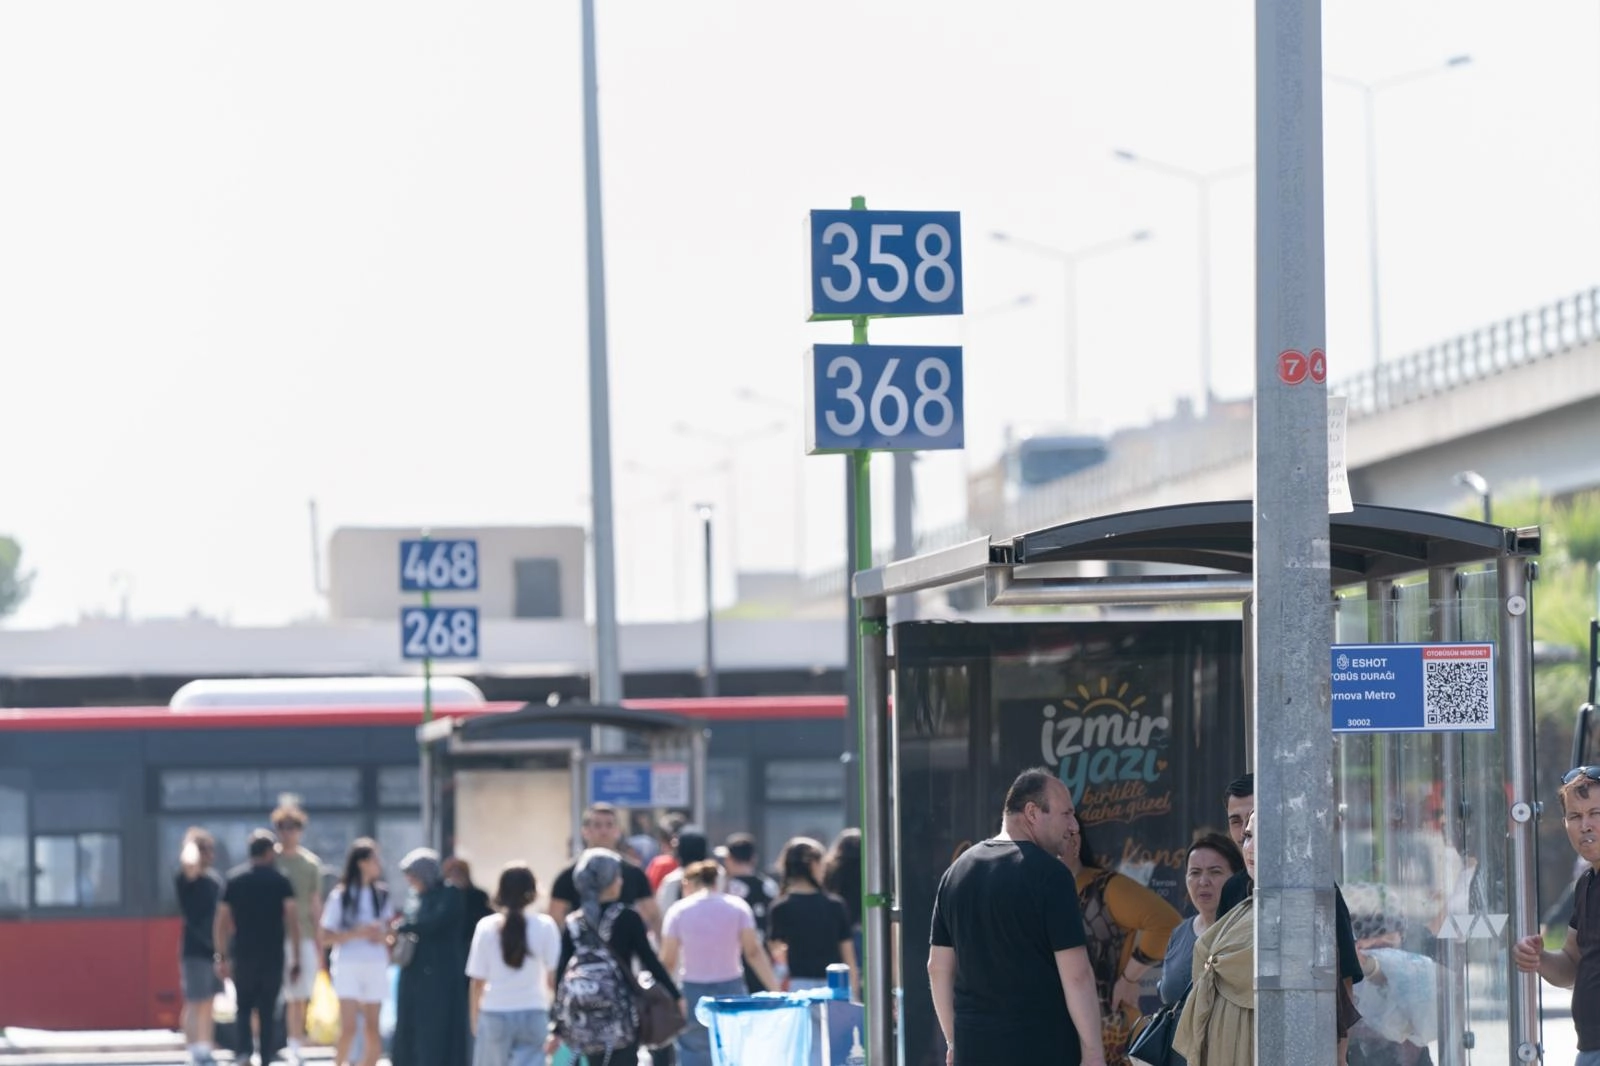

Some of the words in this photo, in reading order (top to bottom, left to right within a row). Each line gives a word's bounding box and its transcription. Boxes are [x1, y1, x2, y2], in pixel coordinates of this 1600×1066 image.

[820, 222, 955, 303] 358
[1285, 359, 1300, 376] 7
[1313, 358, 1324, 375] 4
[825, 356, 954, 437] 368
[403, 541, 475, 588] 468
[405, 610, 475, 656] 268
[1352, 658, 1388, 668] ESHOT
[1331, 671, 1359, 681] OBÜS
[1360, 670, 1395, 681] DURAĞI
[1331, 692, 1362, 701] rnova
[1364, 690, 1396, 700] Metro
[1347, 718, 1371, 727] 30002
